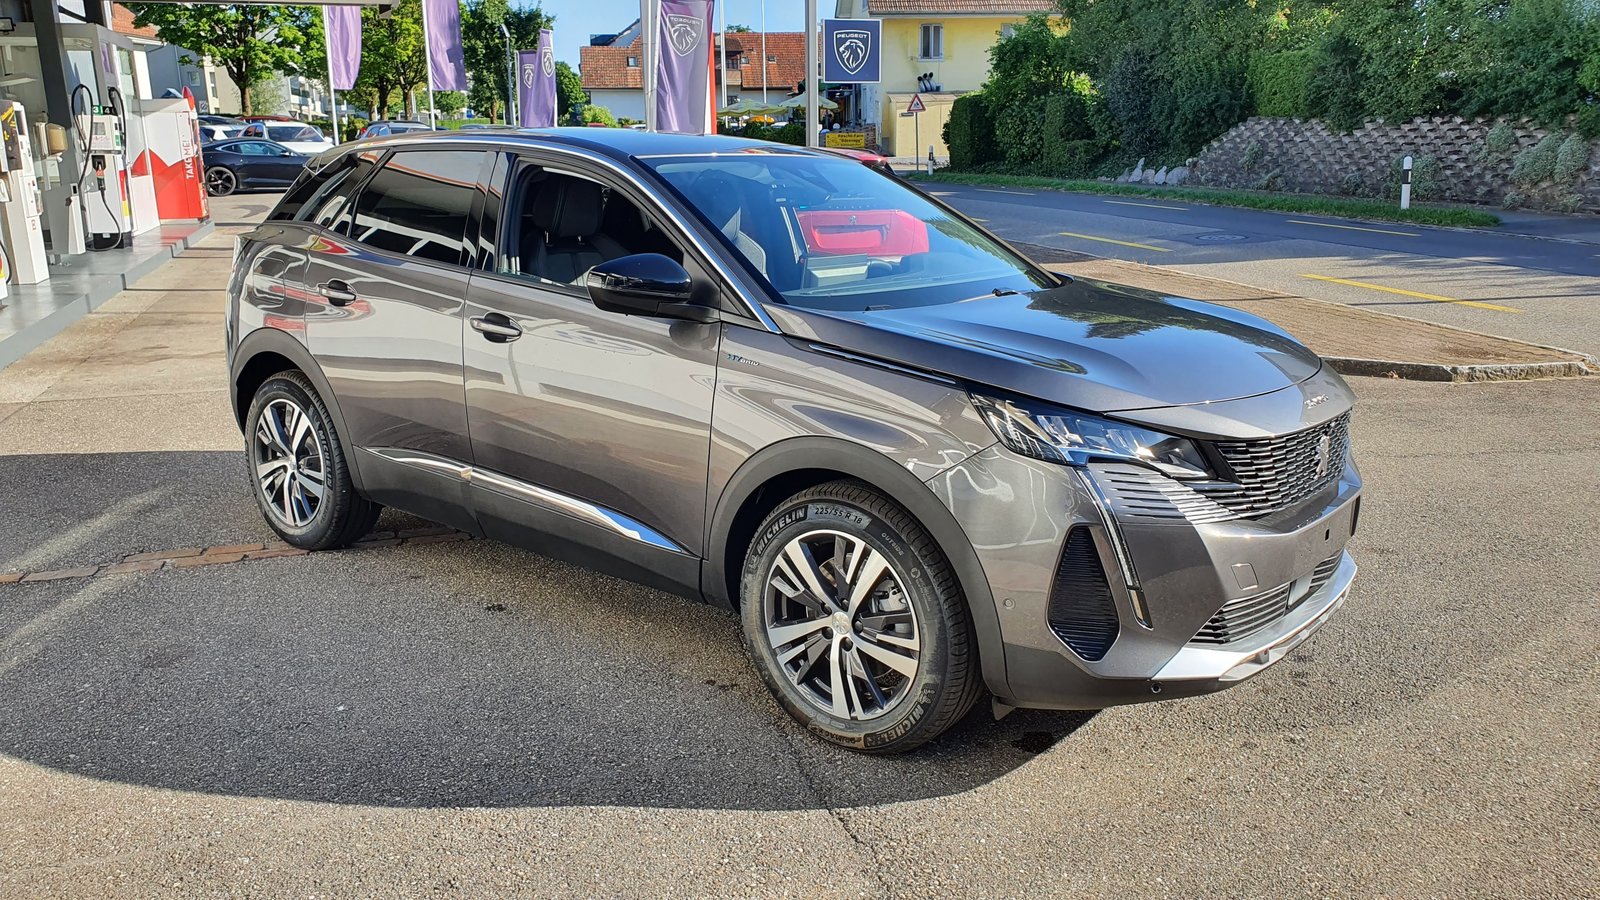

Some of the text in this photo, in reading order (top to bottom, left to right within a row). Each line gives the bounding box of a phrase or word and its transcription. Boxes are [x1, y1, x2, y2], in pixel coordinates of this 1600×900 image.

[185, 157, 194, 180] TAKE
[318, 429, 333, 488] MICHELIN
[815, 507, 843, 517] 225/55
[853, 515, 863, 524] 18
[756, 507, 805, 554] MICHELIN
[881, 532, 905, 556] OUTSIDE
